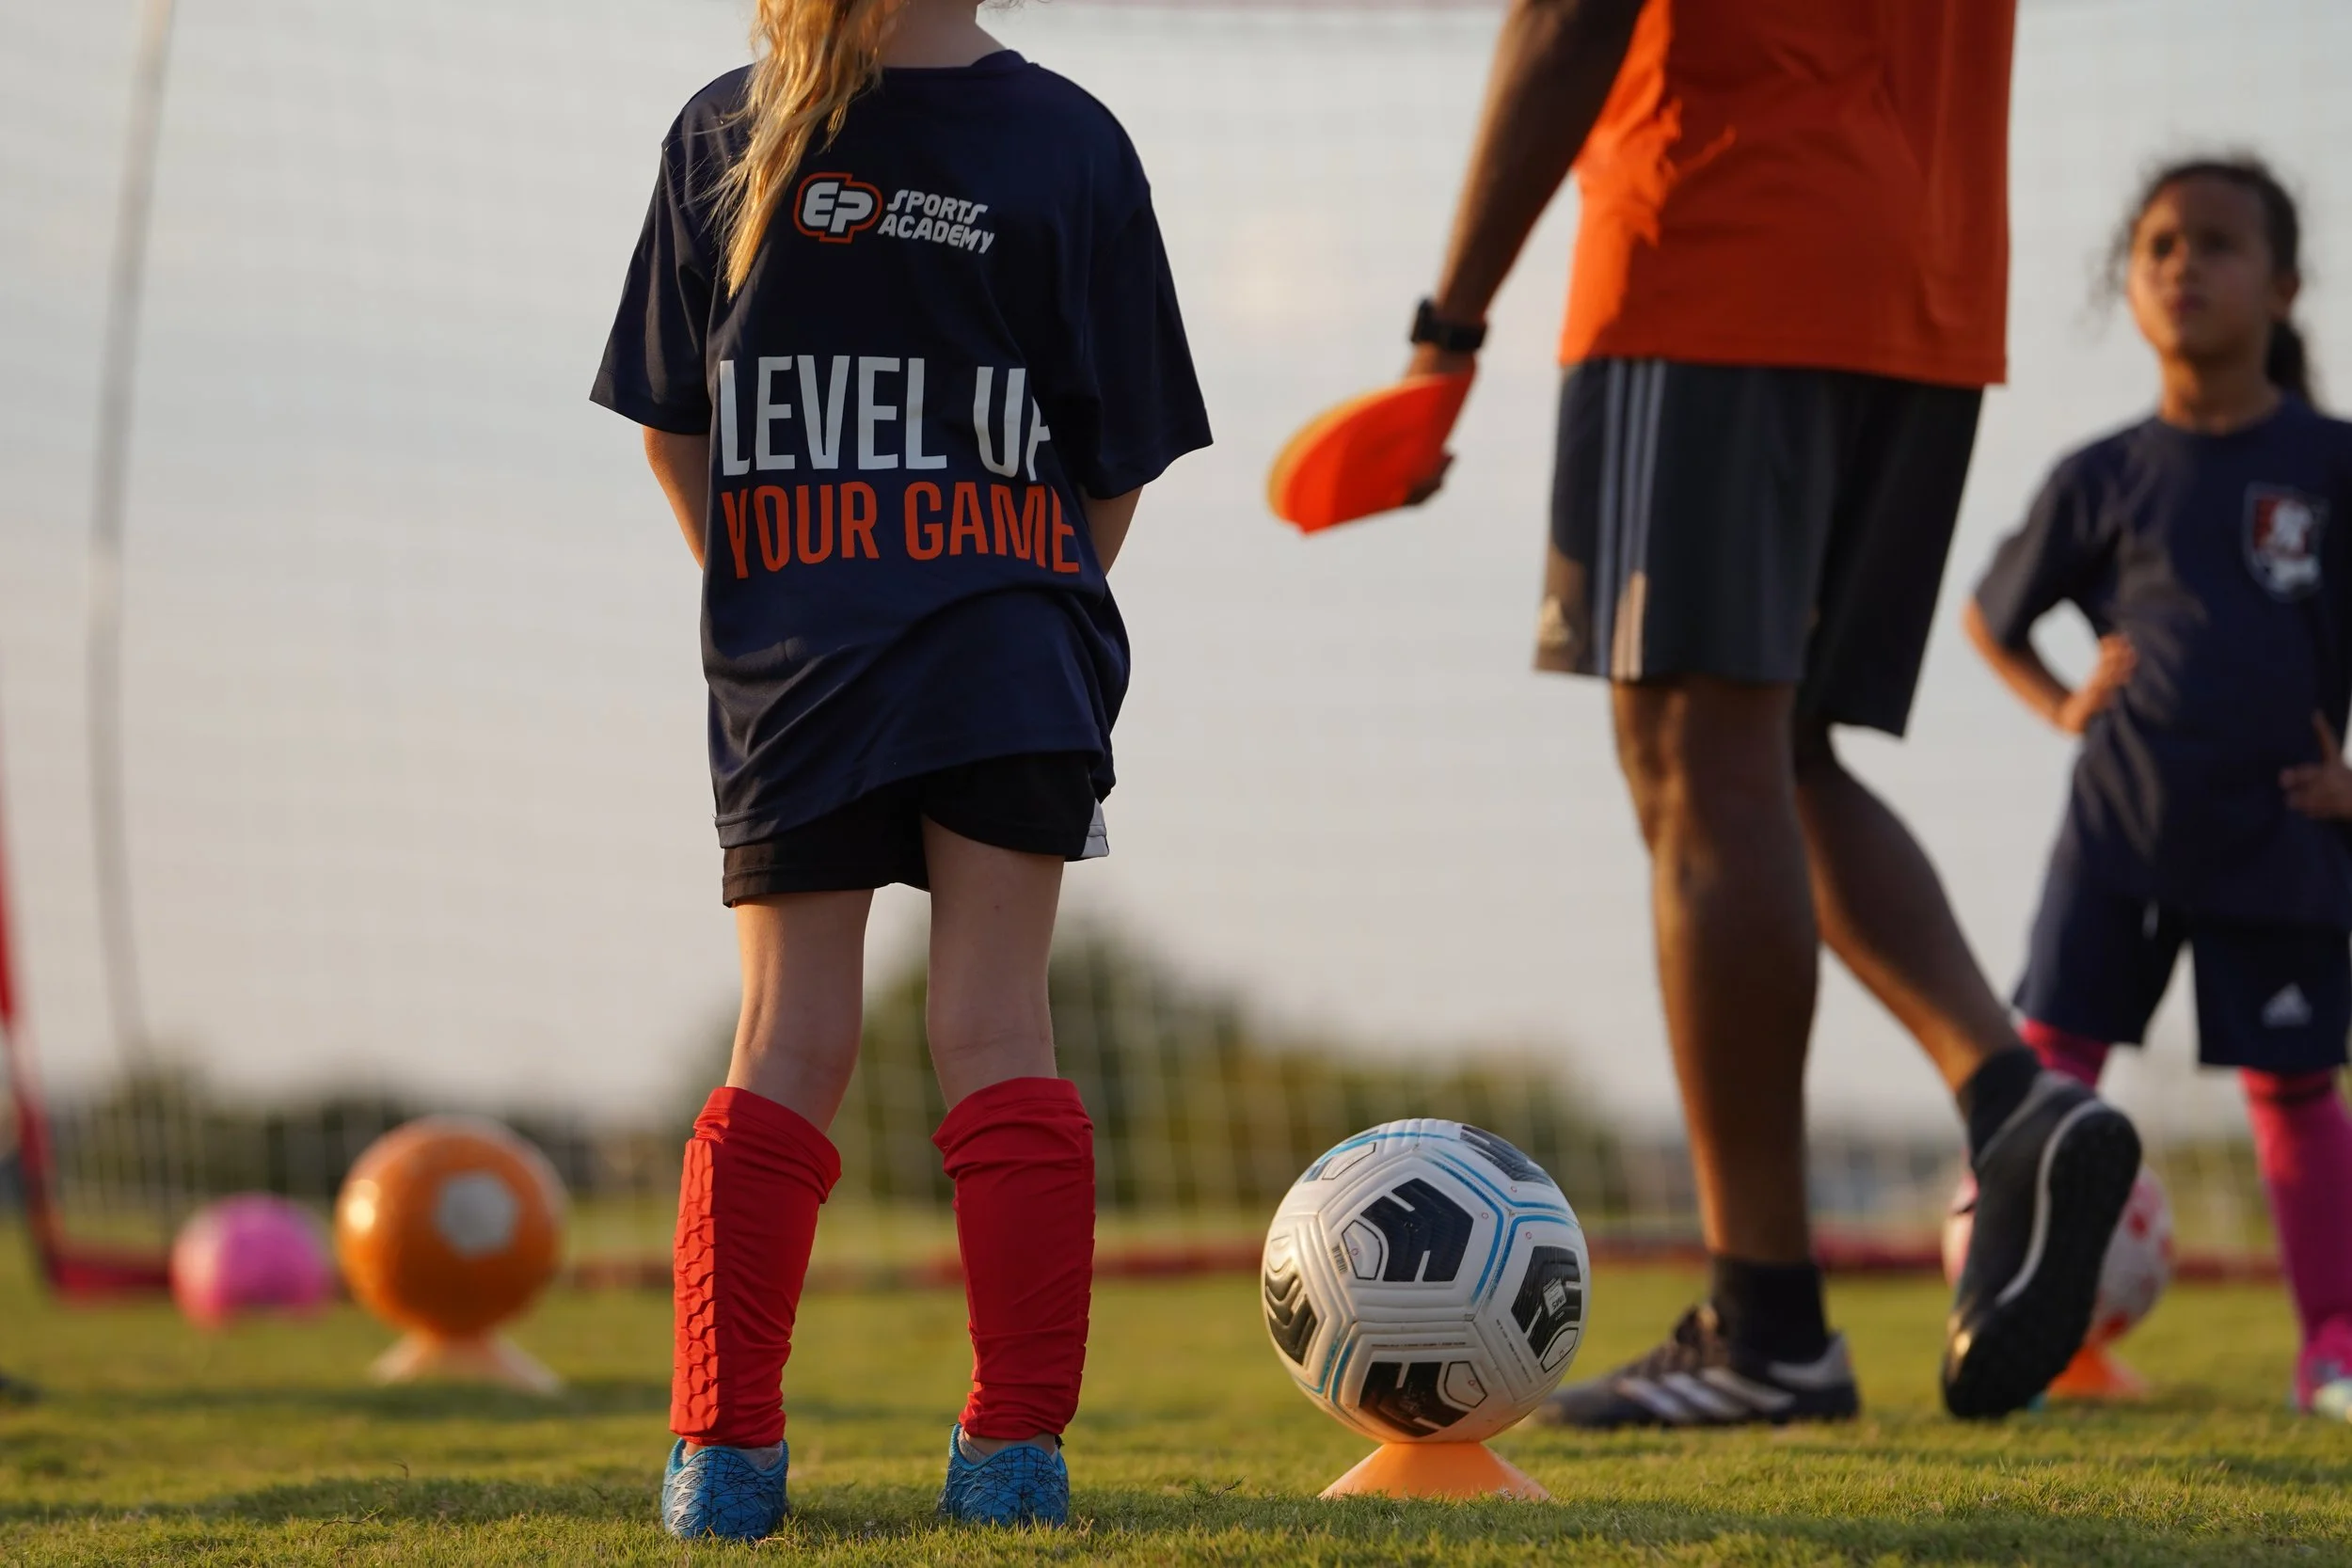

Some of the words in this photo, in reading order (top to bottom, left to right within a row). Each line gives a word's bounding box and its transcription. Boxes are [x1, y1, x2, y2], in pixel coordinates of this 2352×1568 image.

[803, 182, 874, 233] EP
[886, 189, 988, 225] SPORTS
[877, 214, 995, 254] ACADEMY
[720, 355, 947, 476] LEVEL
[721, 481, 880, 578] YOUR
[904, 481, 1080, 573] GAME
